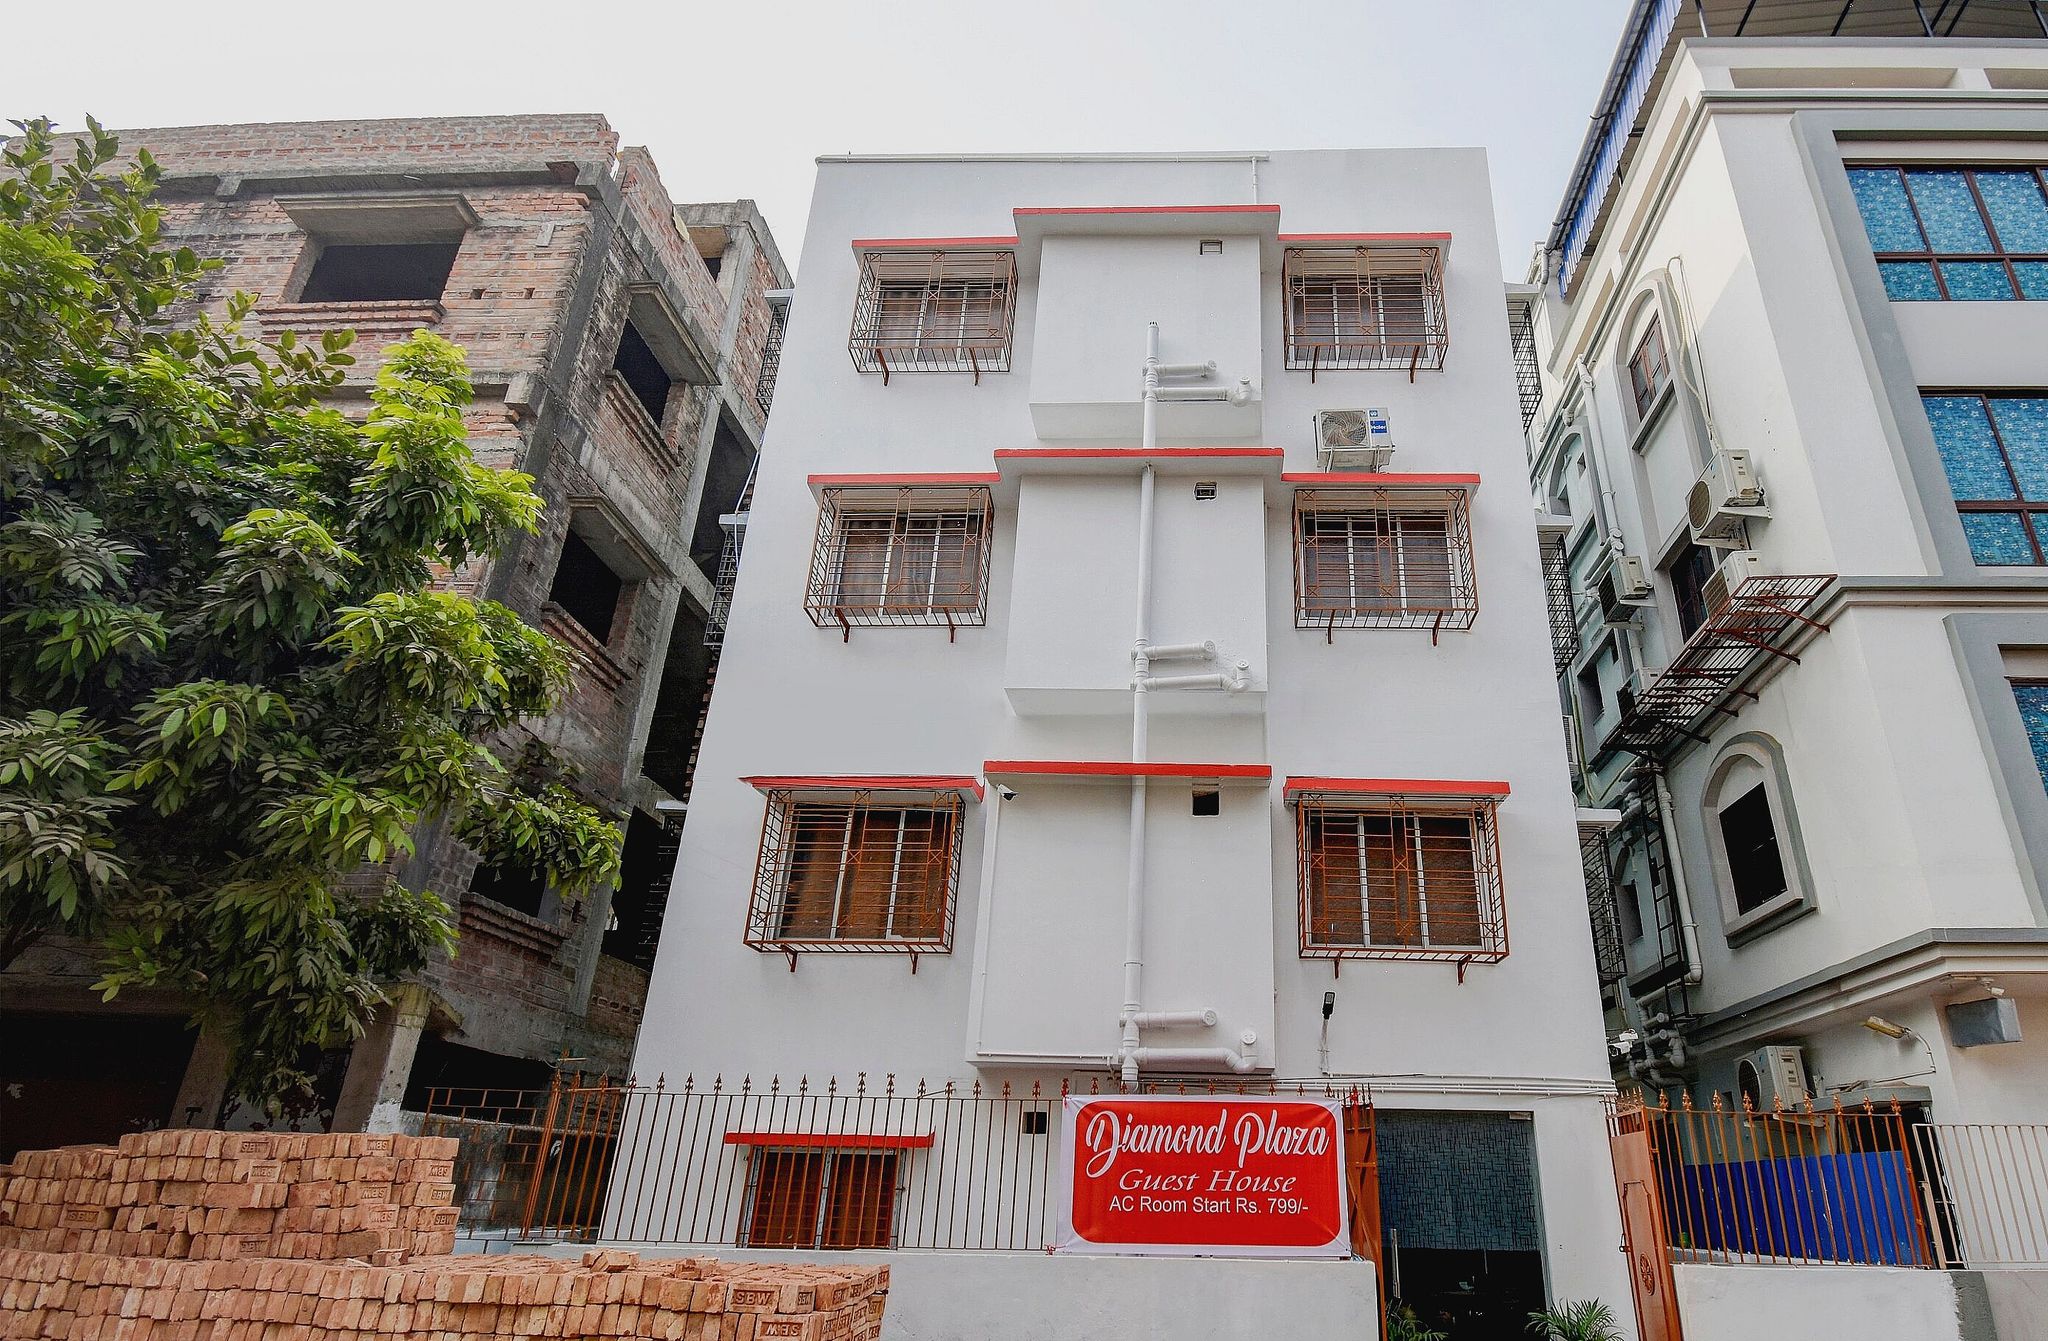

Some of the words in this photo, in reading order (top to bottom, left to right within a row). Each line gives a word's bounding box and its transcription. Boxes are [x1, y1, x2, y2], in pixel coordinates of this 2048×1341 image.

[1085, 1108, 1227, 1178] Diamond
[1233, 1109, 1330, 1168] Plaza
[1119, 1169, 1200, 1192] Guest
[1205, 1170, 1297, 1192] House
[1109, 1196, 1134, 1212] AC
[1140, 1196, 1187, 1213] Room
[1192, 1197, 1231, 1213] Start
[1237, 1198, 1262, 1213] Rs.
[1267, 1198, 1309, 1215] 799/-
[736, 1291, 771, 1306] SBW
